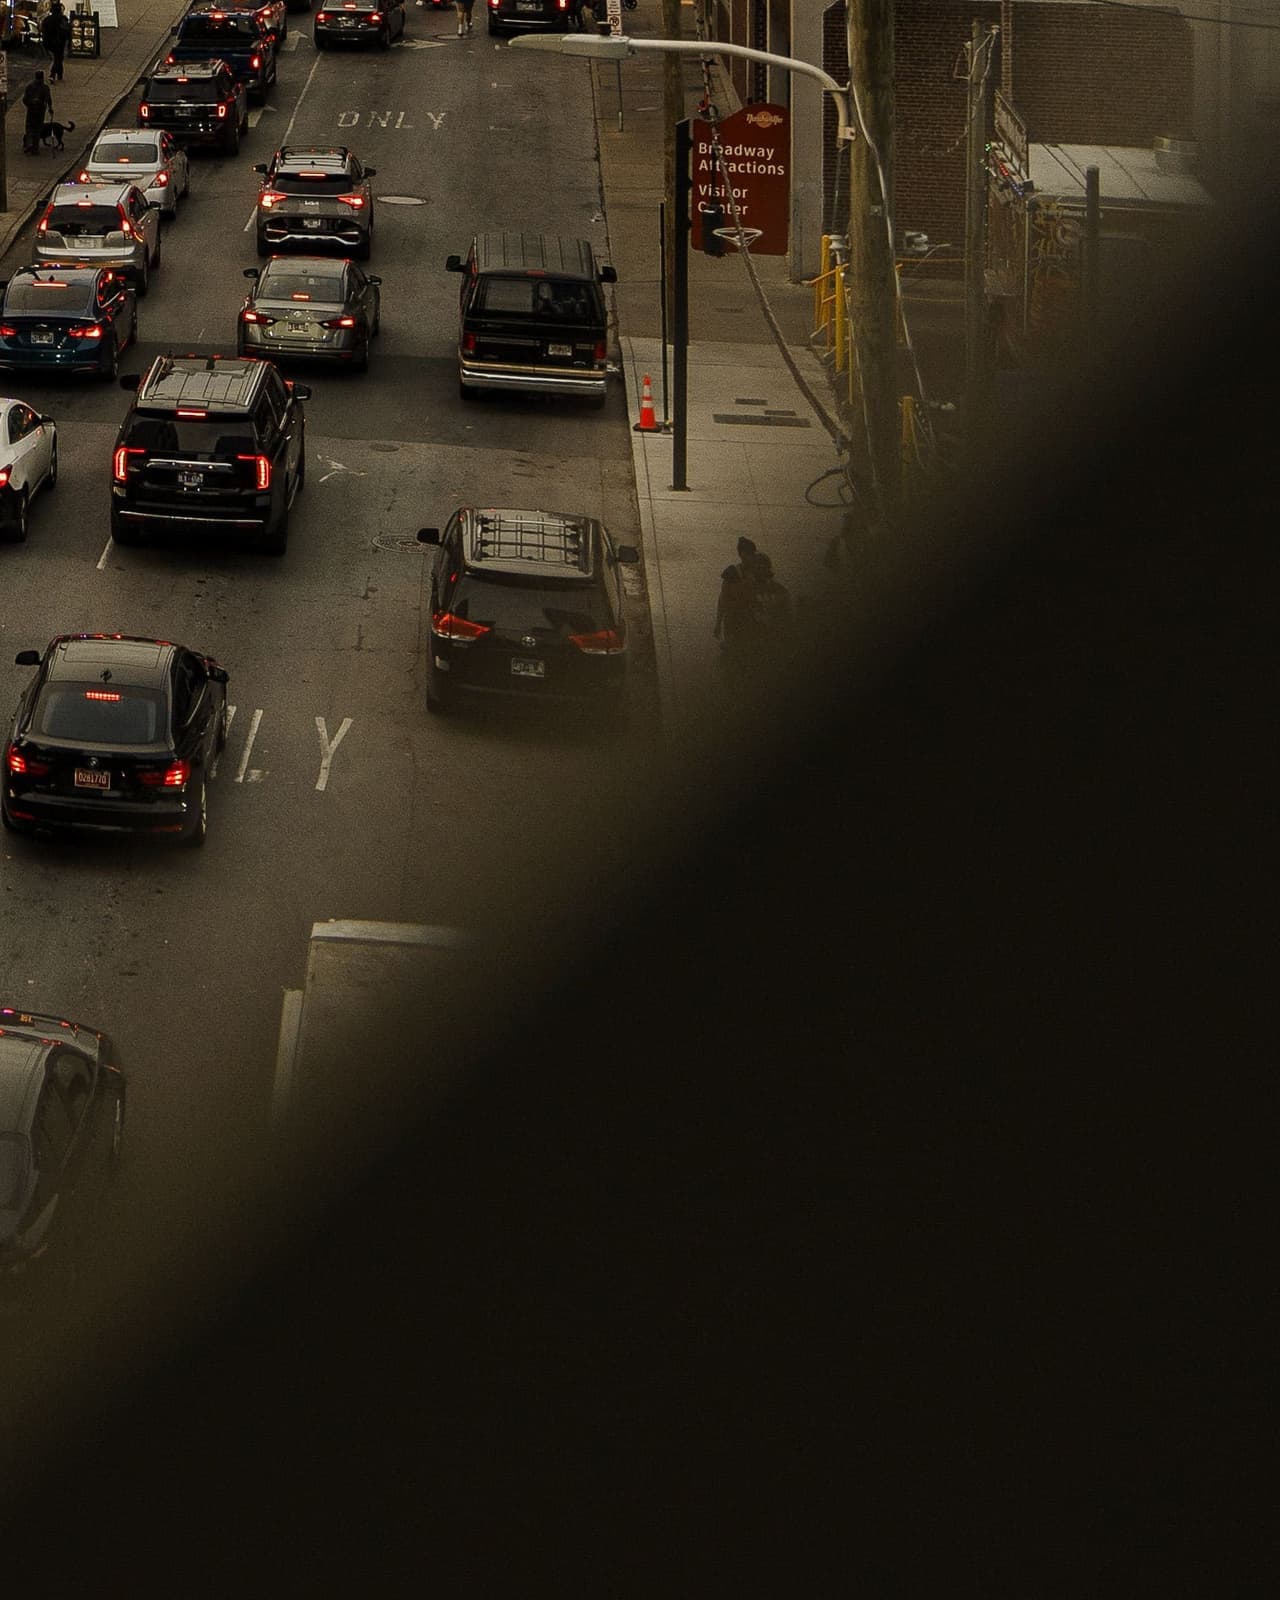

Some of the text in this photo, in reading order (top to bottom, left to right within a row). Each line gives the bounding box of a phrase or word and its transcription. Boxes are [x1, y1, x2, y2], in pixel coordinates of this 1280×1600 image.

[337, 111, 447, 130] ONLY
[698, 183, 749, 199] Visior
[697, 201, 749, 216] Cnter
